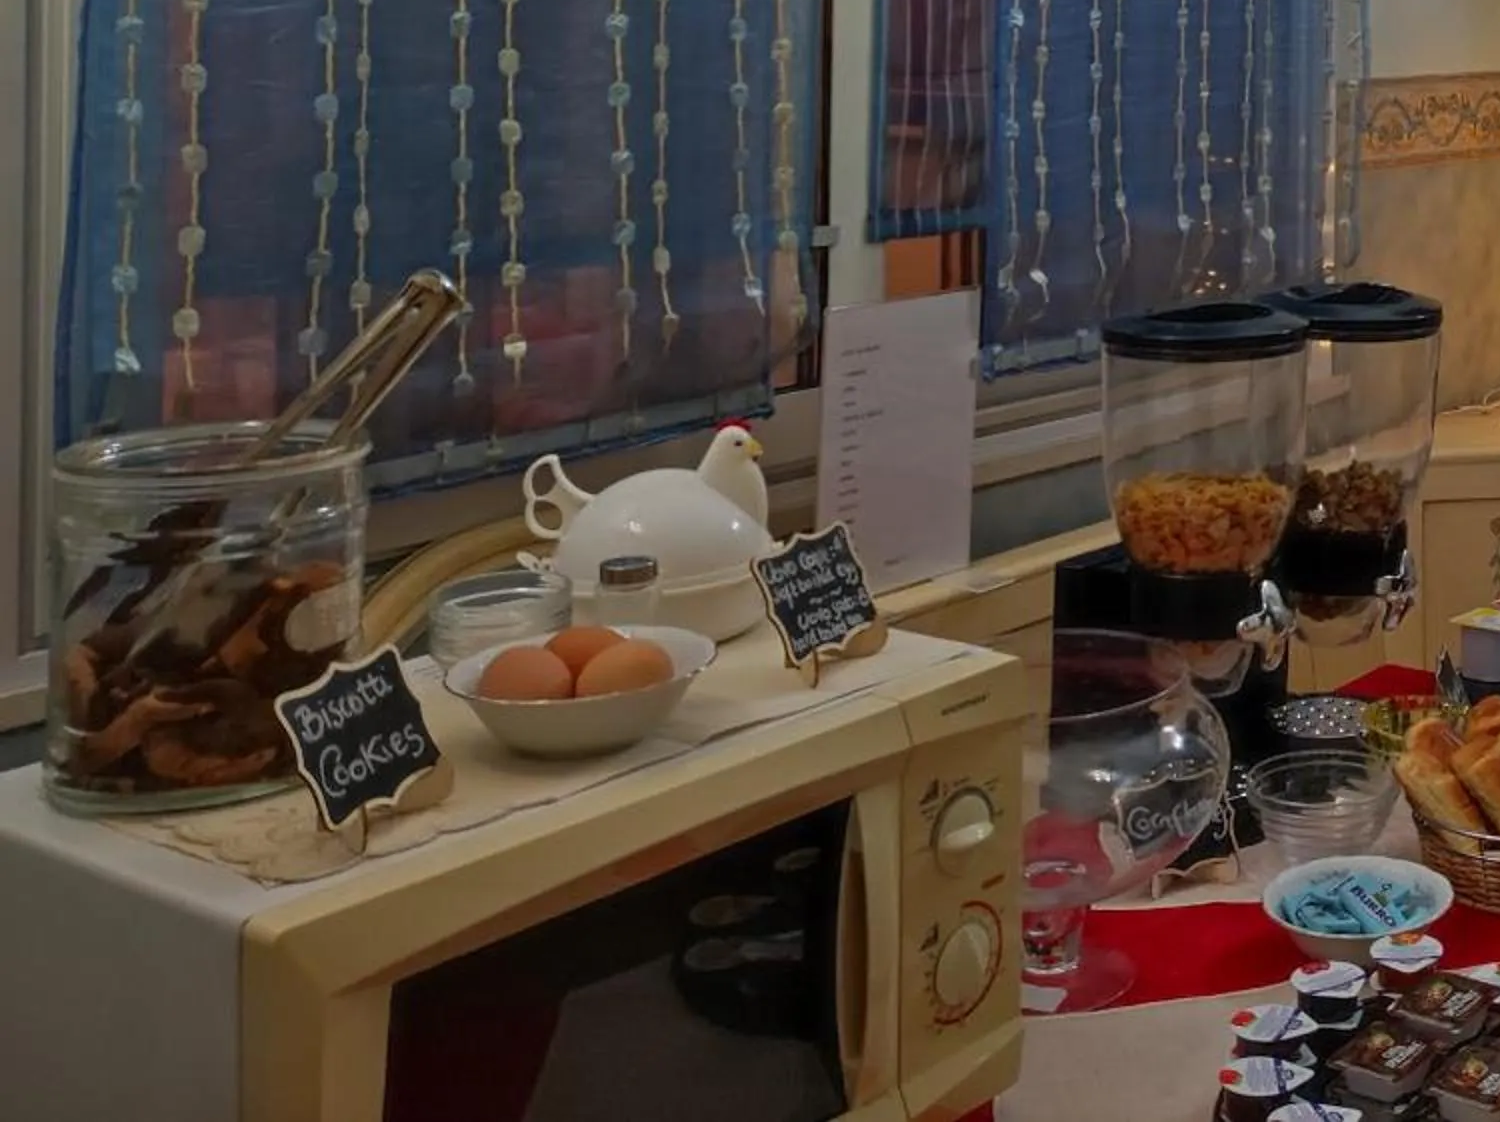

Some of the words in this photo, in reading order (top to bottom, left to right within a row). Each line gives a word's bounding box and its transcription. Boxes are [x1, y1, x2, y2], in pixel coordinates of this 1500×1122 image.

[294, 665, 394, 743] Biscotti
[319, 723, 425, 798] Cookies
[1350, 885, 1397, 927] BURRO
